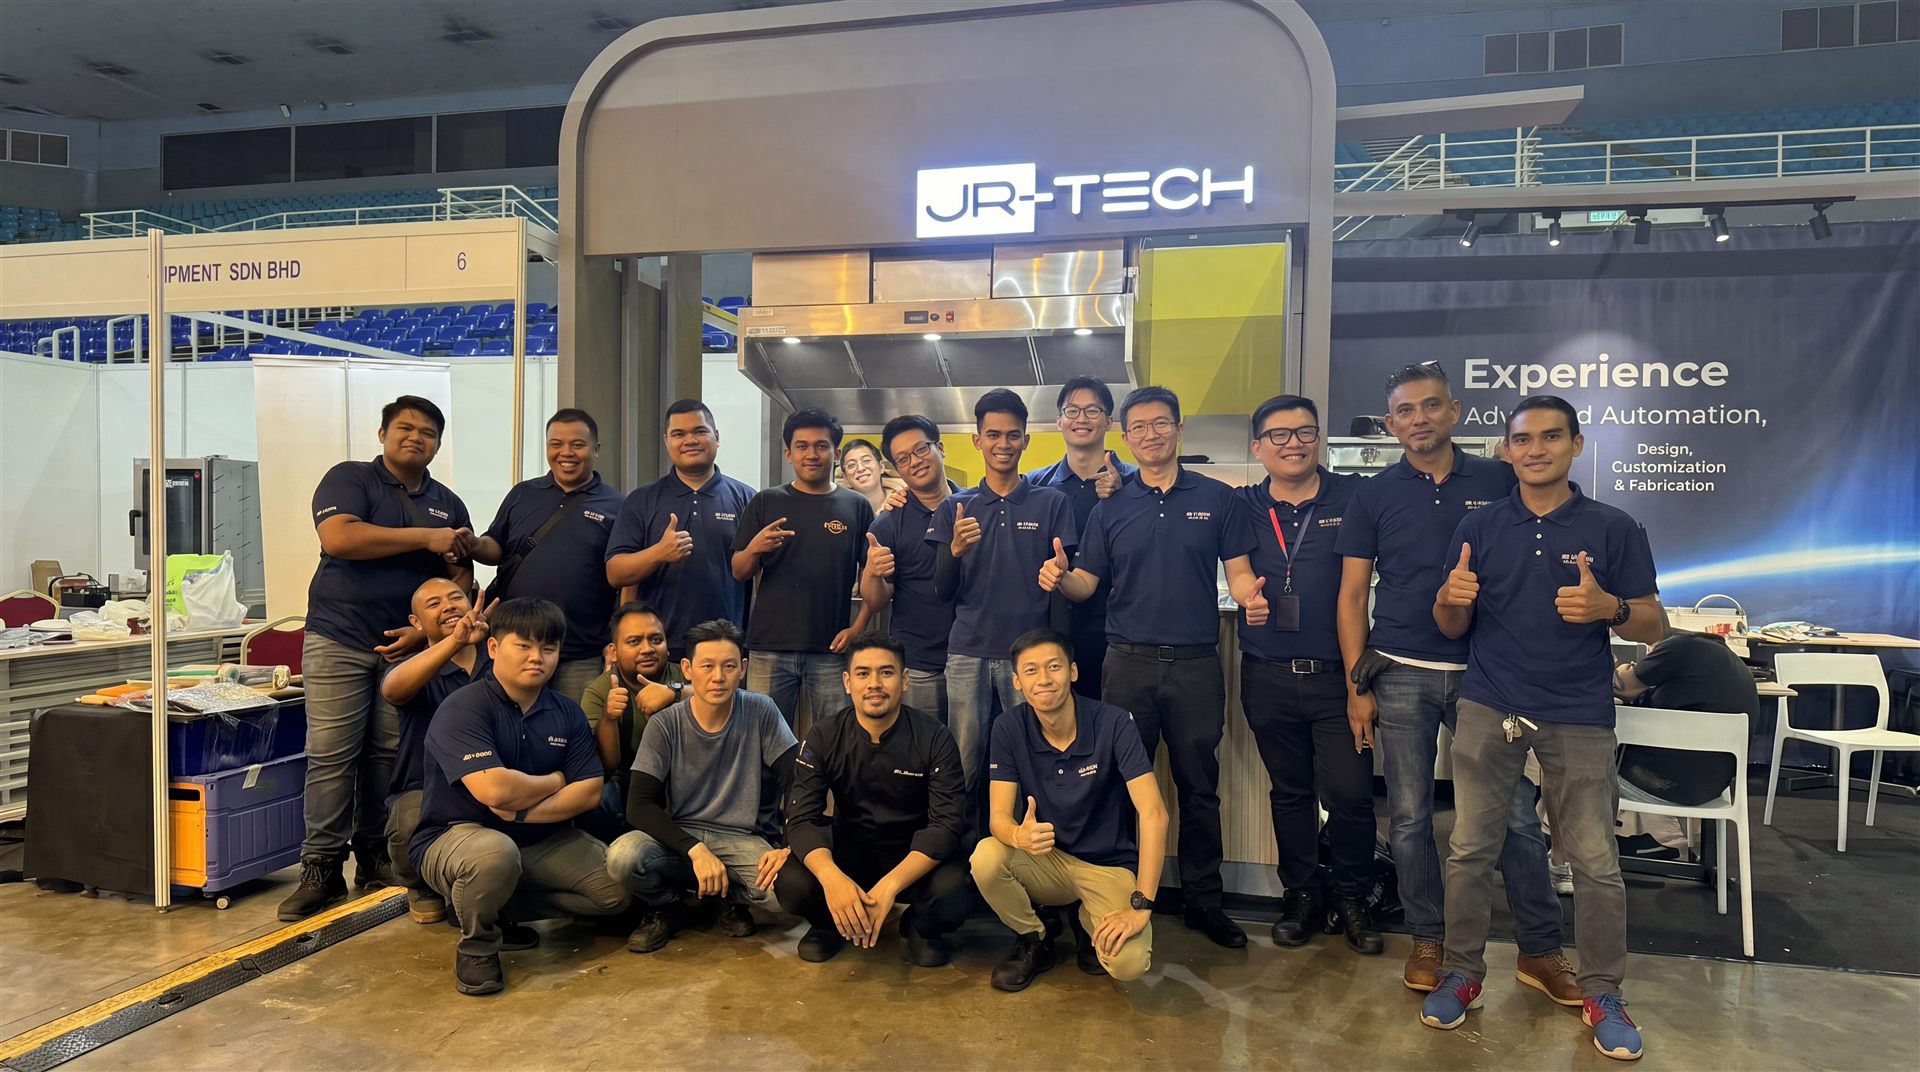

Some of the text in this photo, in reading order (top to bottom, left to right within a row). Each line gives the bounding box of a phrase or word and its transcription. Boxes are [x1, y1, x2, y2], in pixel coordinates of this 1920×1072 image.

[925, 165, 1254, 222] JR-TECH
[164, 260, 301, 283] IPMENT SDN BHD
[457, 251, 467, 271] 6
[1464, 353, 1729, 396] Experience
[1464, 404, 1767, 428] Advd Automation,
[1637, 443, 1693, 458] Design,
[1611, 460, 1727, 474] Customization
[1614, 479, 1715, 492] & Fabrication
